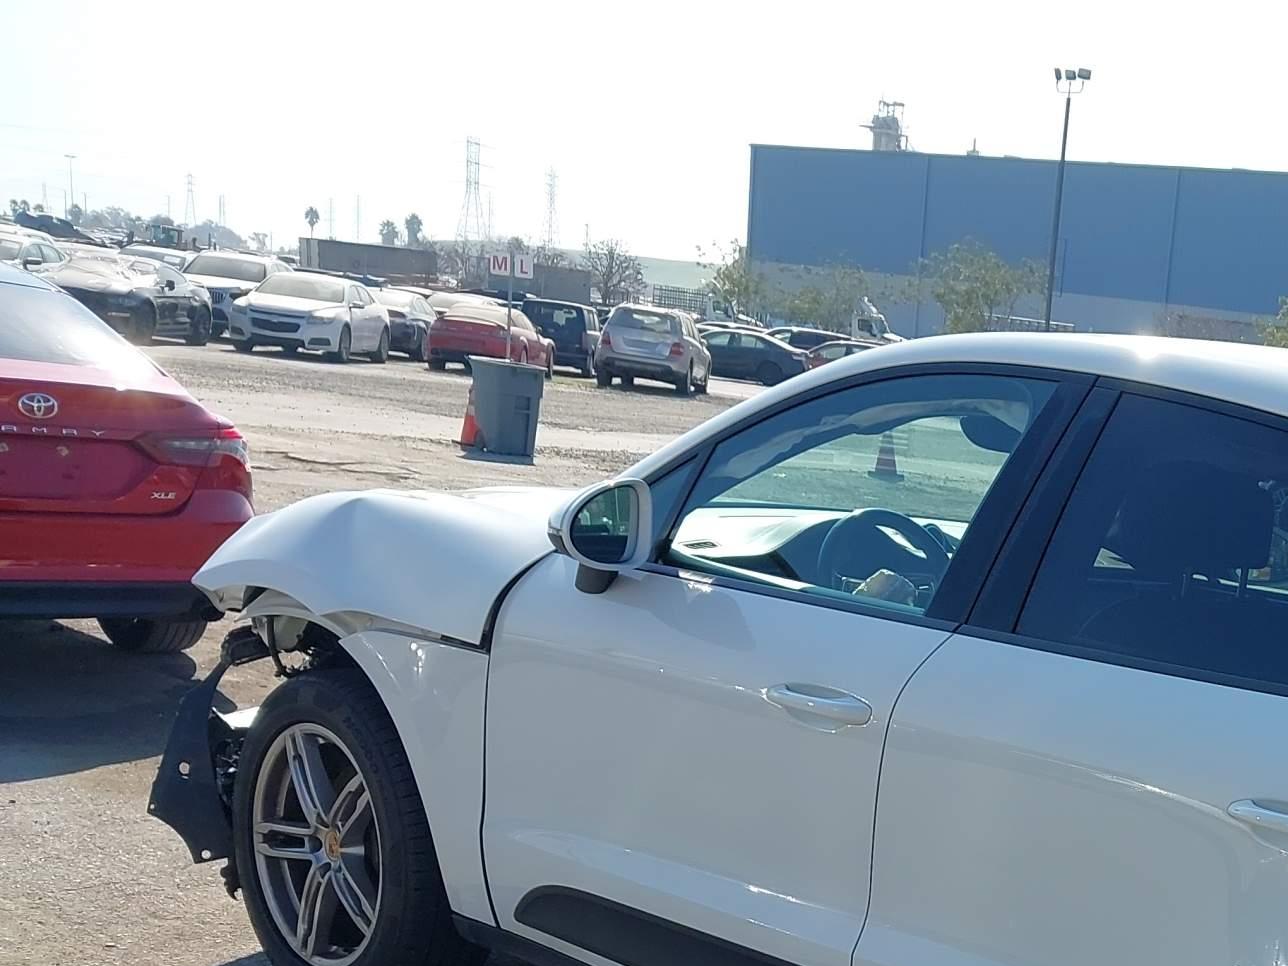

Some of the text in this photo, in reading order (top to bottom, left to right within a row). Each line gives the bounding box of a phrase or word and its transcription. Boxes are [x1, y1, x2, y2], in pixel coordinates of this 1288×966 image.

[493, 255, 508, 271] M
[520, 259, 528, 275] L
[0, 424, 105, 437] AMRY
[151, 491, 176, 500] XLE
